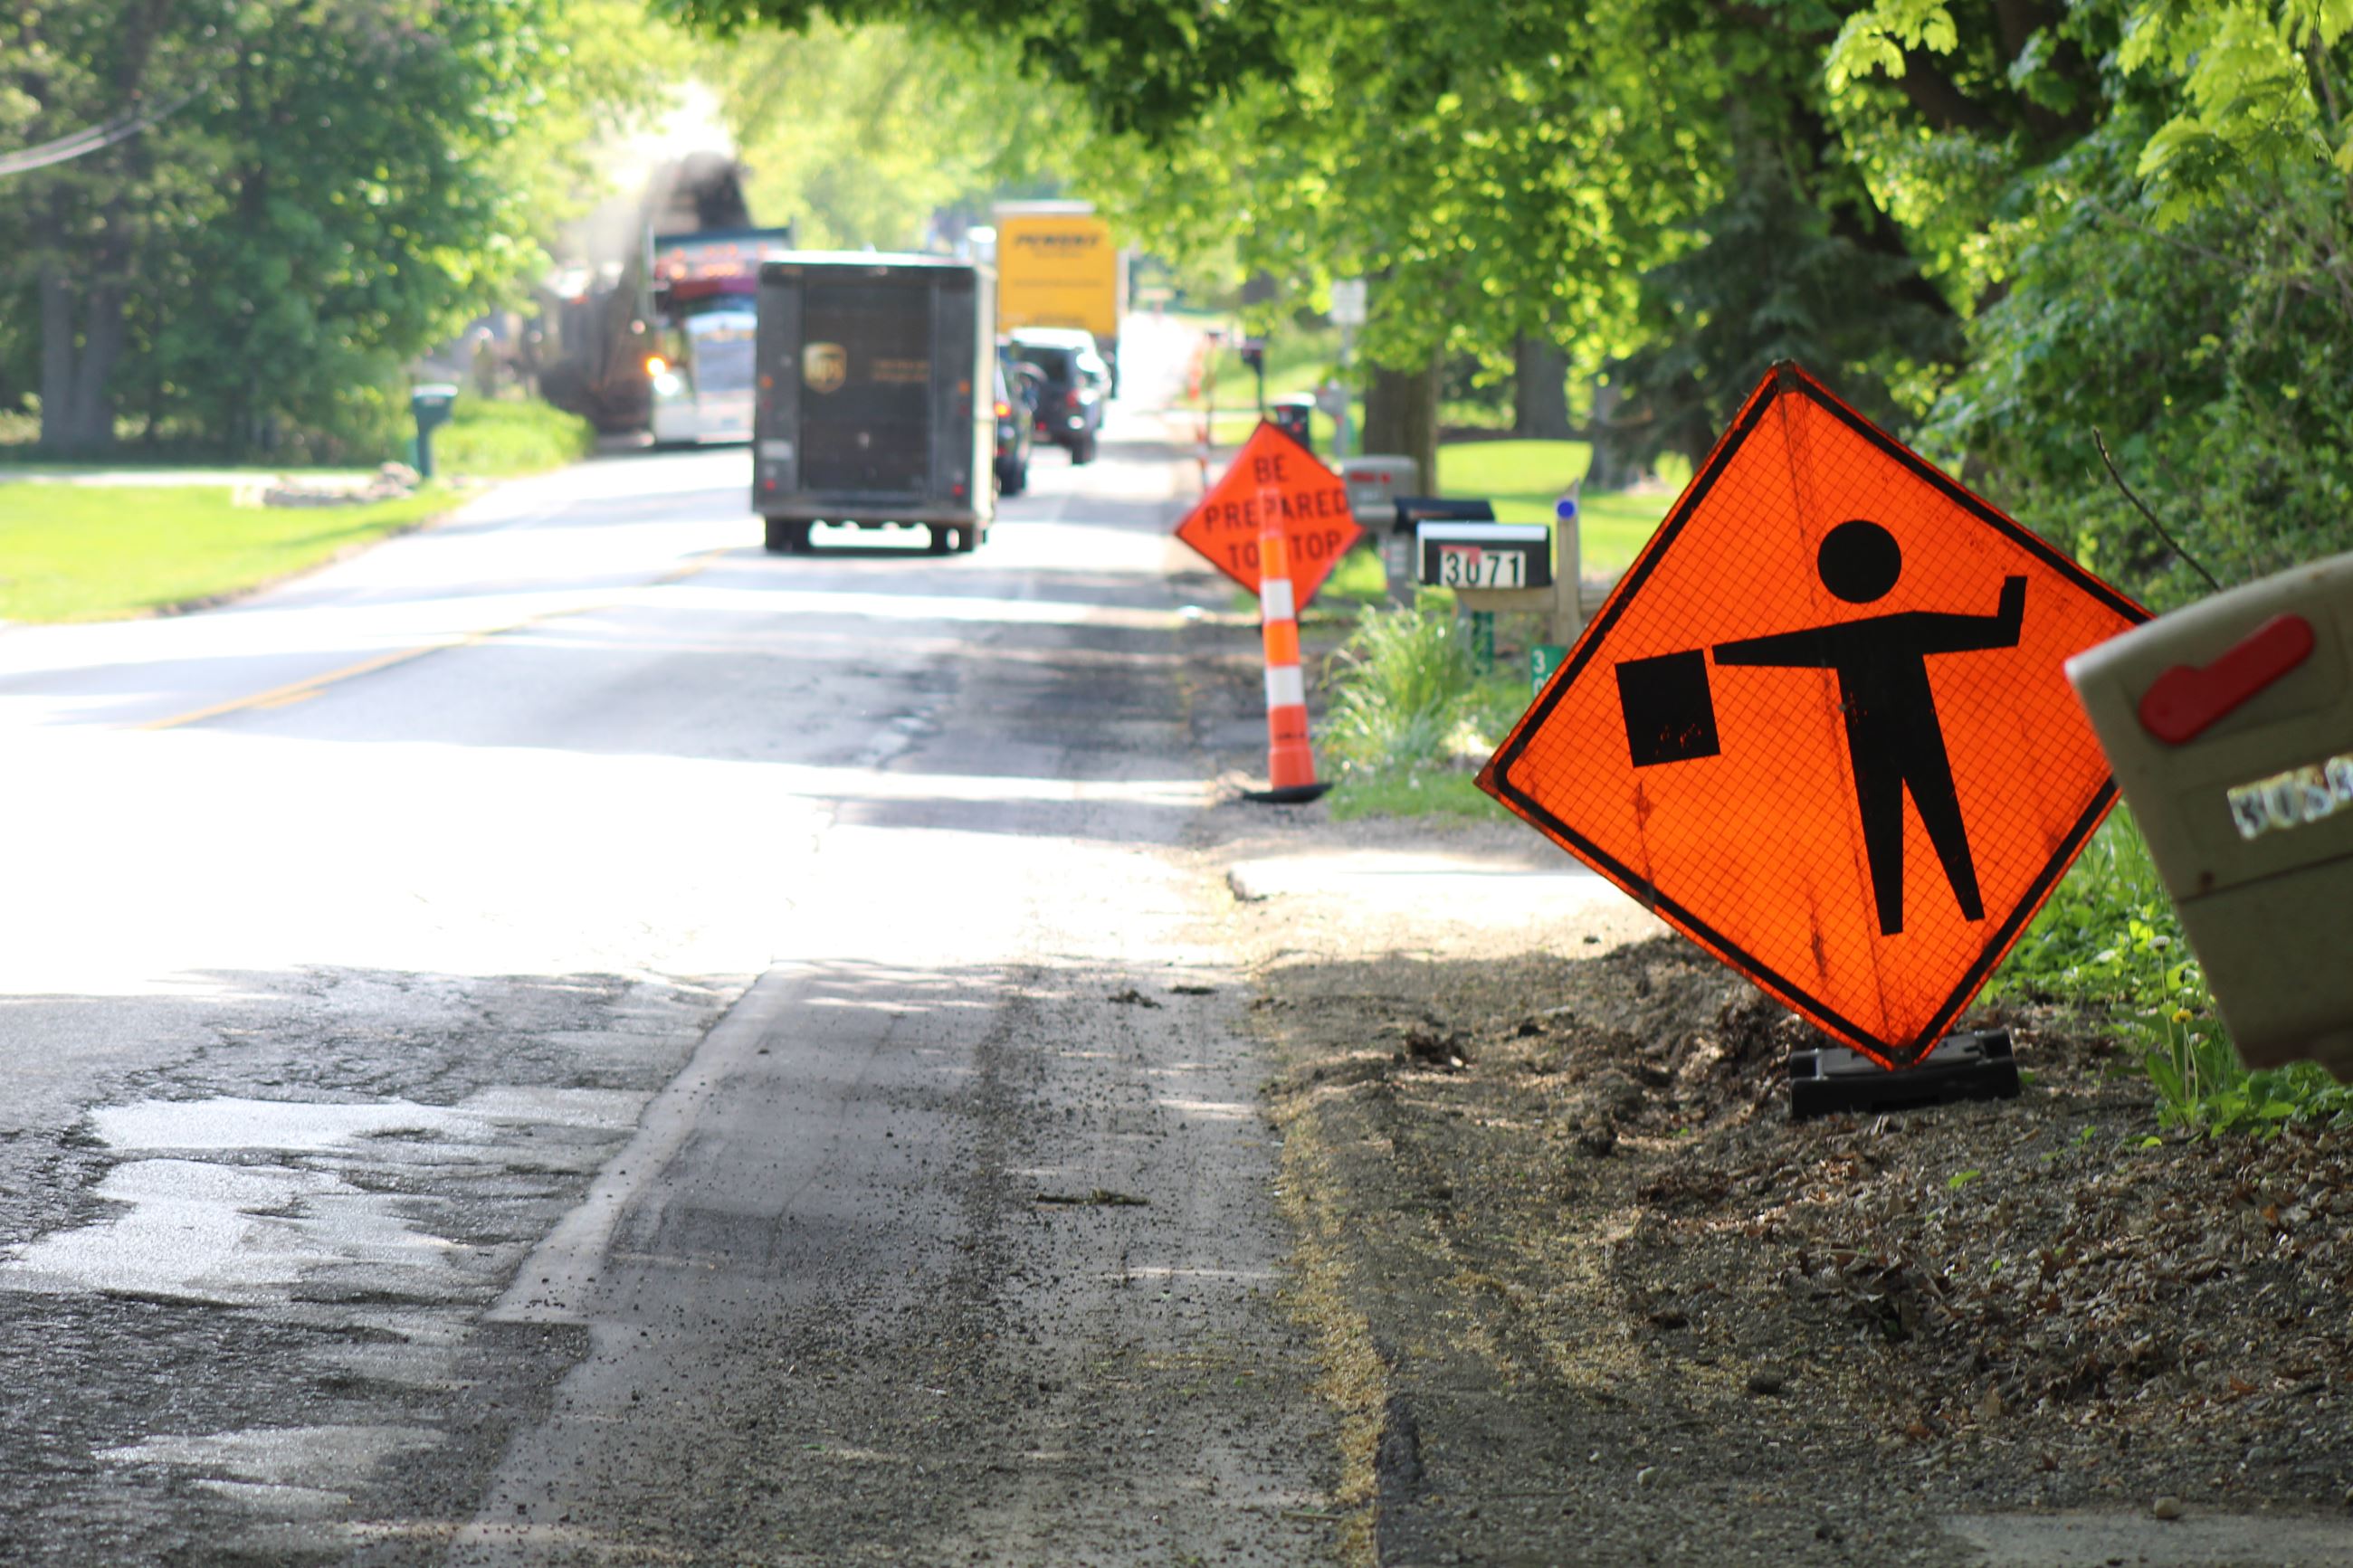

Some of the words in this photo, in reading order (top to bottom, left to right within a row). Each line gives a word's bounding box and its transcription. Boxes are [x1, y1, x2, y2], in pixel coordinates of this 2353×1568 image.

[1253, 453, 1289, 484] BE
[1204, 488, 1348, 531] PREPARED
[1445, 553, 1520, 584] 3071
